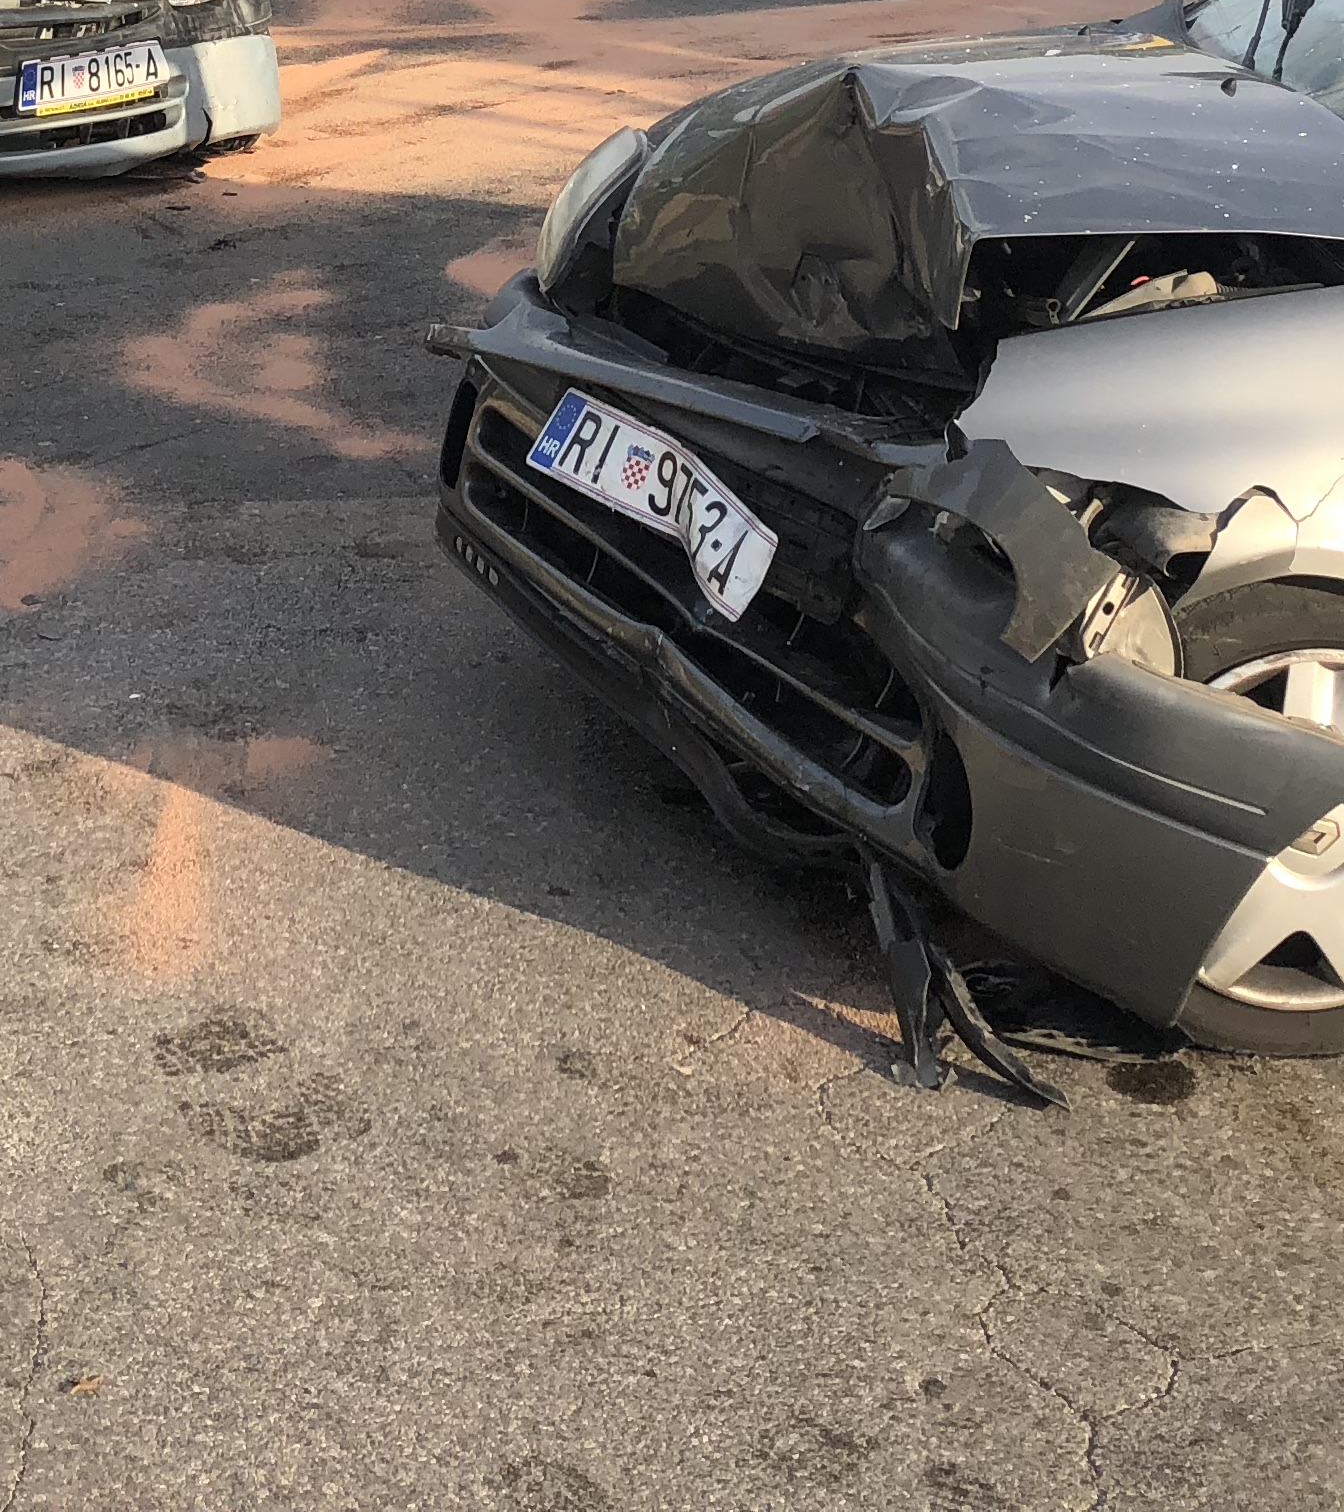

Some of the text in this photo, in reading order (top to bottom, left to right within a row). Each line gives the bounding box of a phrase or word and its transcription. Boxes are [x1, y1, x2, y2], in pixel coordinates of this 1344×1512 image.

[23, 47, 159, 102] HR RI 8165-A
[537, 436, 561, 458] HR
[558, 410, 621, 485] RI
